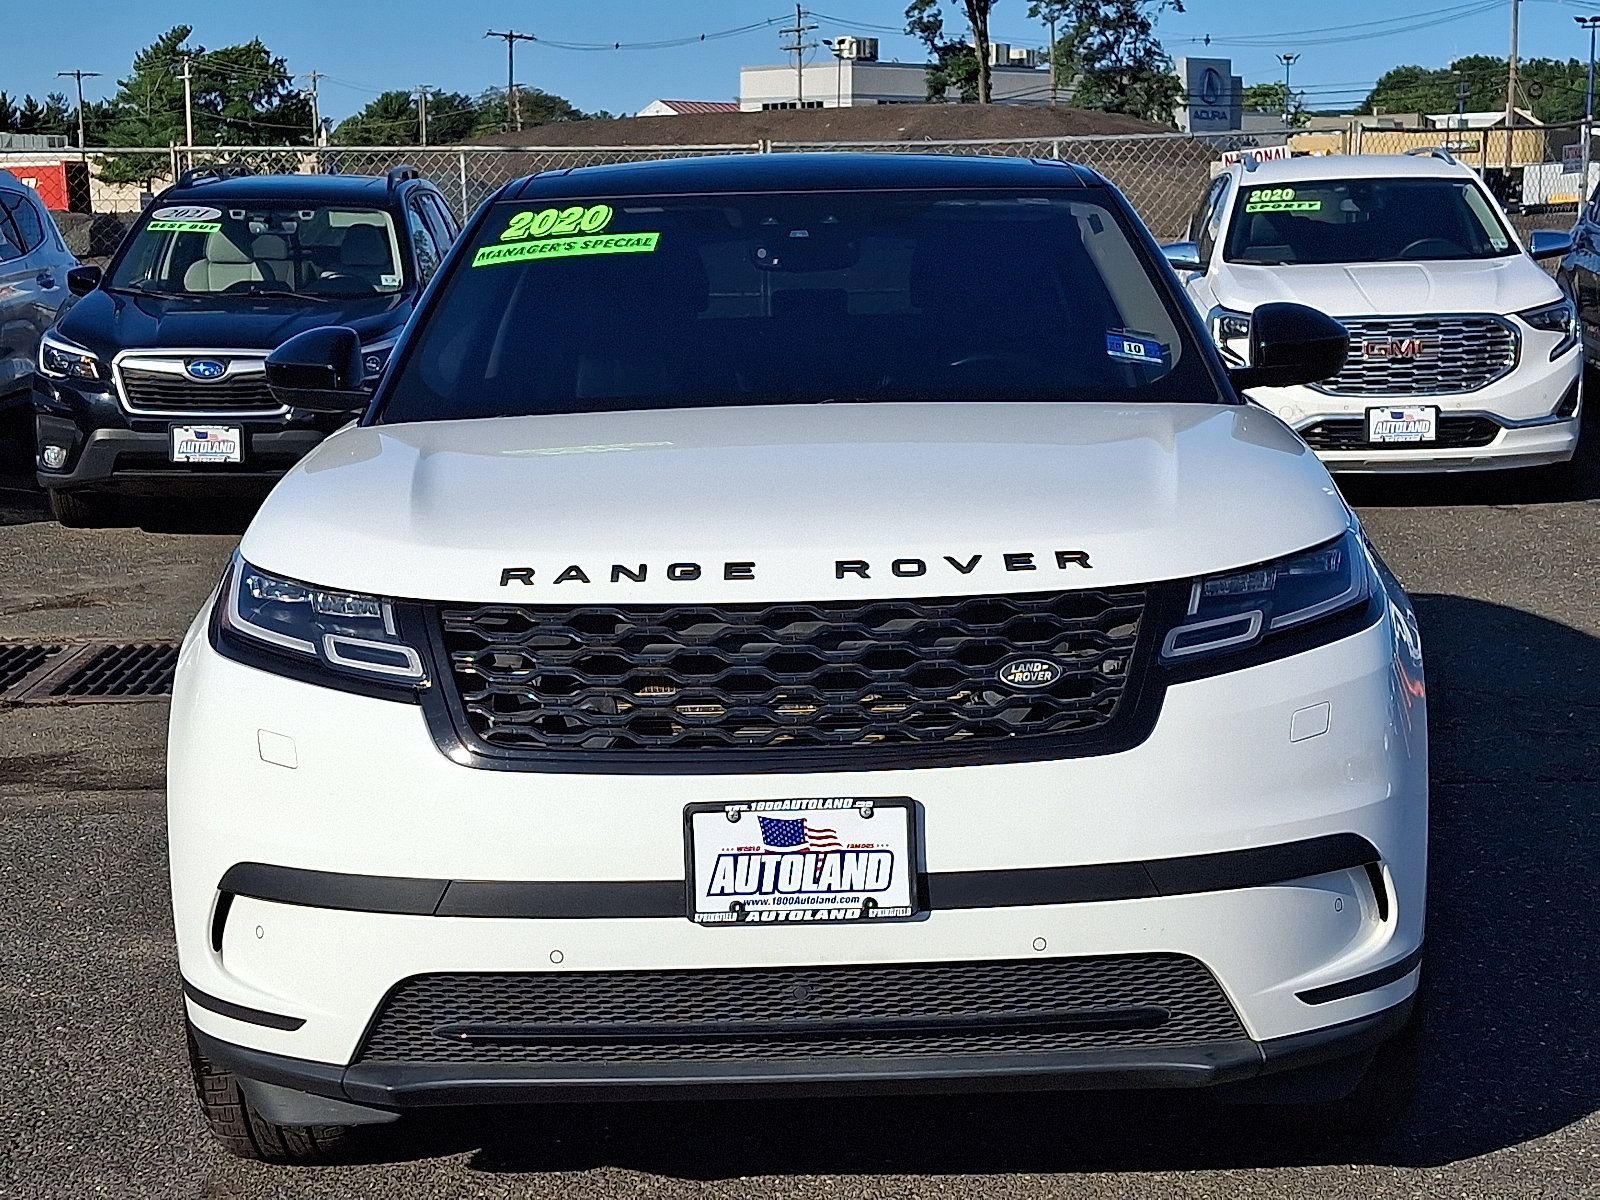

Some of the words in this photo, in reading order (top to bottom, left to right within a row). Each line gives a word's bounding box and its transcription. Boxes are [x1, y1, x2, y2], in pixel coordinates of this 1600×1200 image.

[1193, 110, 1228, 120] ACURA
[1249, 188, 1295, 202] 2020
[162, 209, 211, 218] 2021
[1248, 202, 1318, 211] SPORTY
[500, 204, 613, 241] 2020
[477, 241, 578, 262] MANAGER'S
[580, 236, 653, 250] SPECIAL
[1127, 343, 1142, 354] 10
[1362, 338, 1441, 359] GMC
[1374, 419, 1431, 435] AUTOLAND
[178, 440, 236, 454] AUTOLAND
[500, 562, 756, 587] RANGE
[835, 550, 1093, 579] ROVER
[1011, 662, 1042, 673] LAND
[1013, 671, 1052, 682] ROVER
[706, 851, 894, 897] AUTOLAND
[743, 895, 860, 906] www.1800Autoland.com
[745, 908, 861, 922] AUTOLAND
